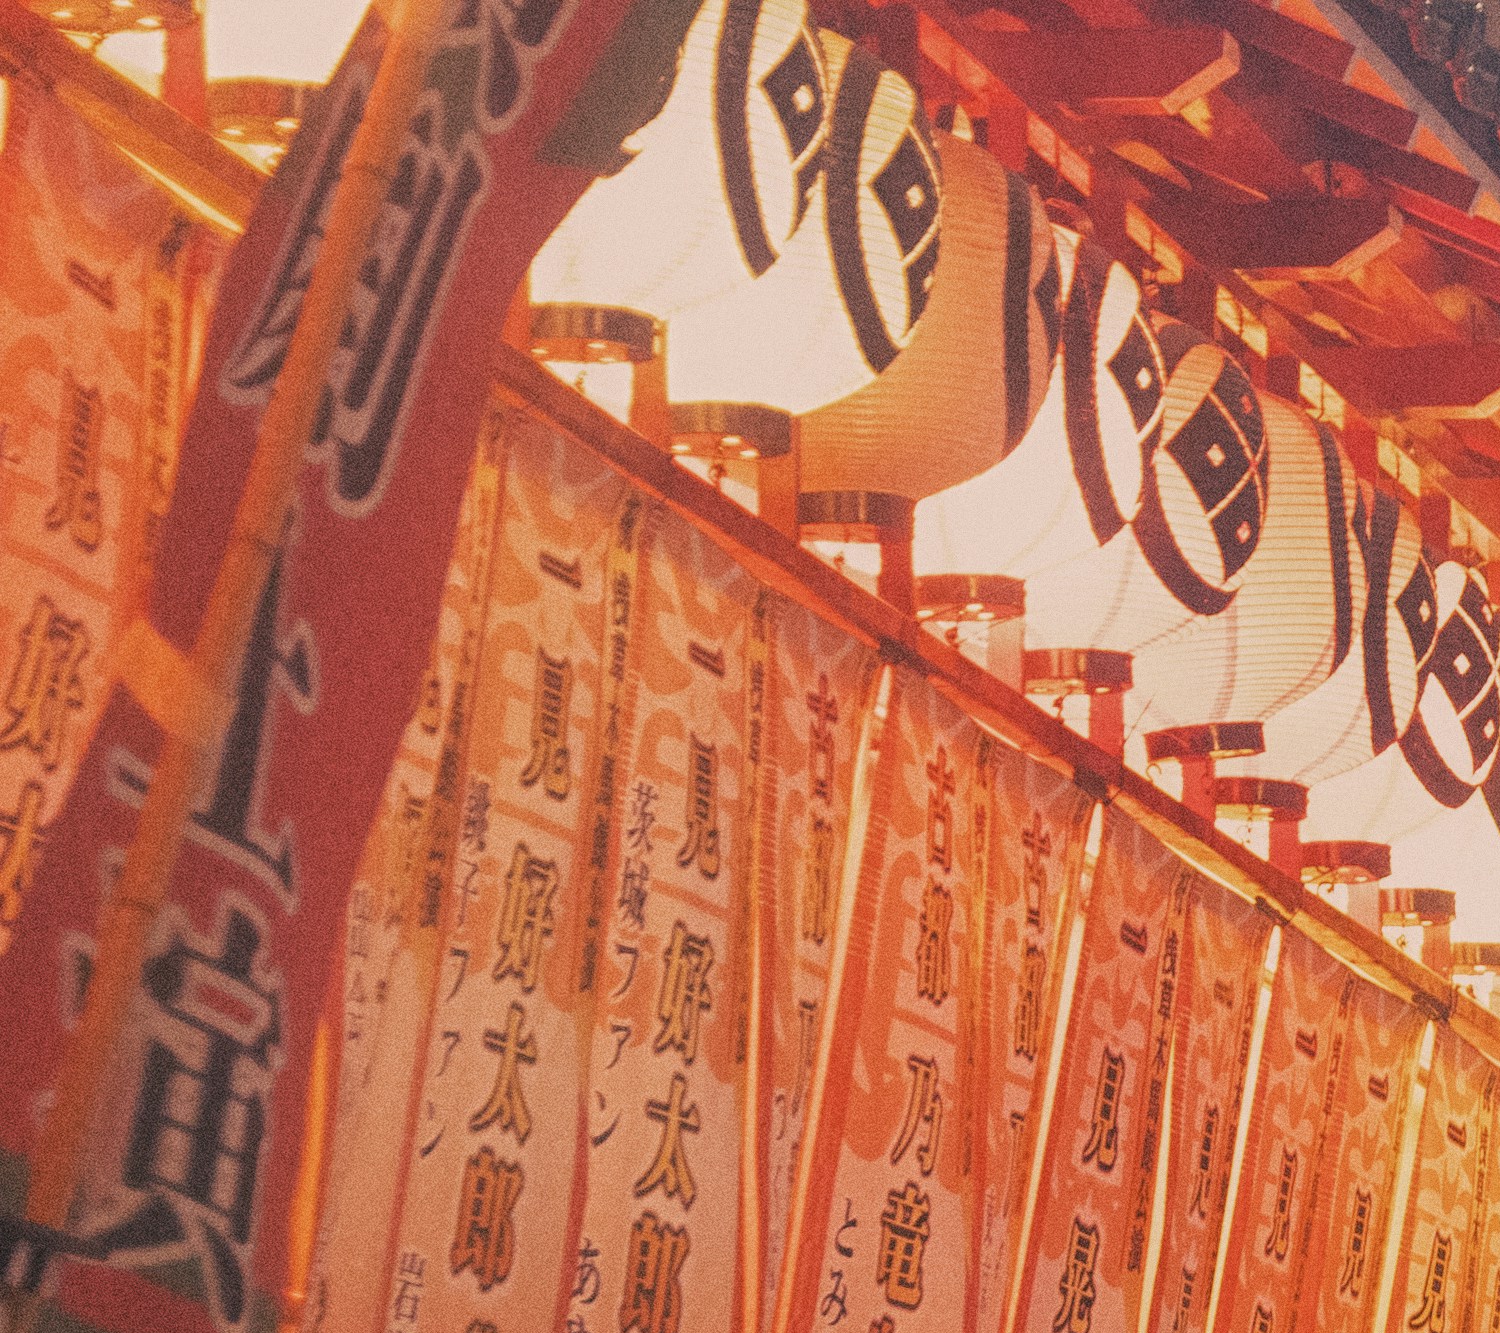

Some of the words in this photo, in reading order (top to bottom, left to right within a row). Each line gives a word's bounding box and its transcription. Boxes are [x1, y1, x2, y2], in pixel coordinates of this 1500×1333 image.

[449, 549, 583, 1292] 一見好太郎
